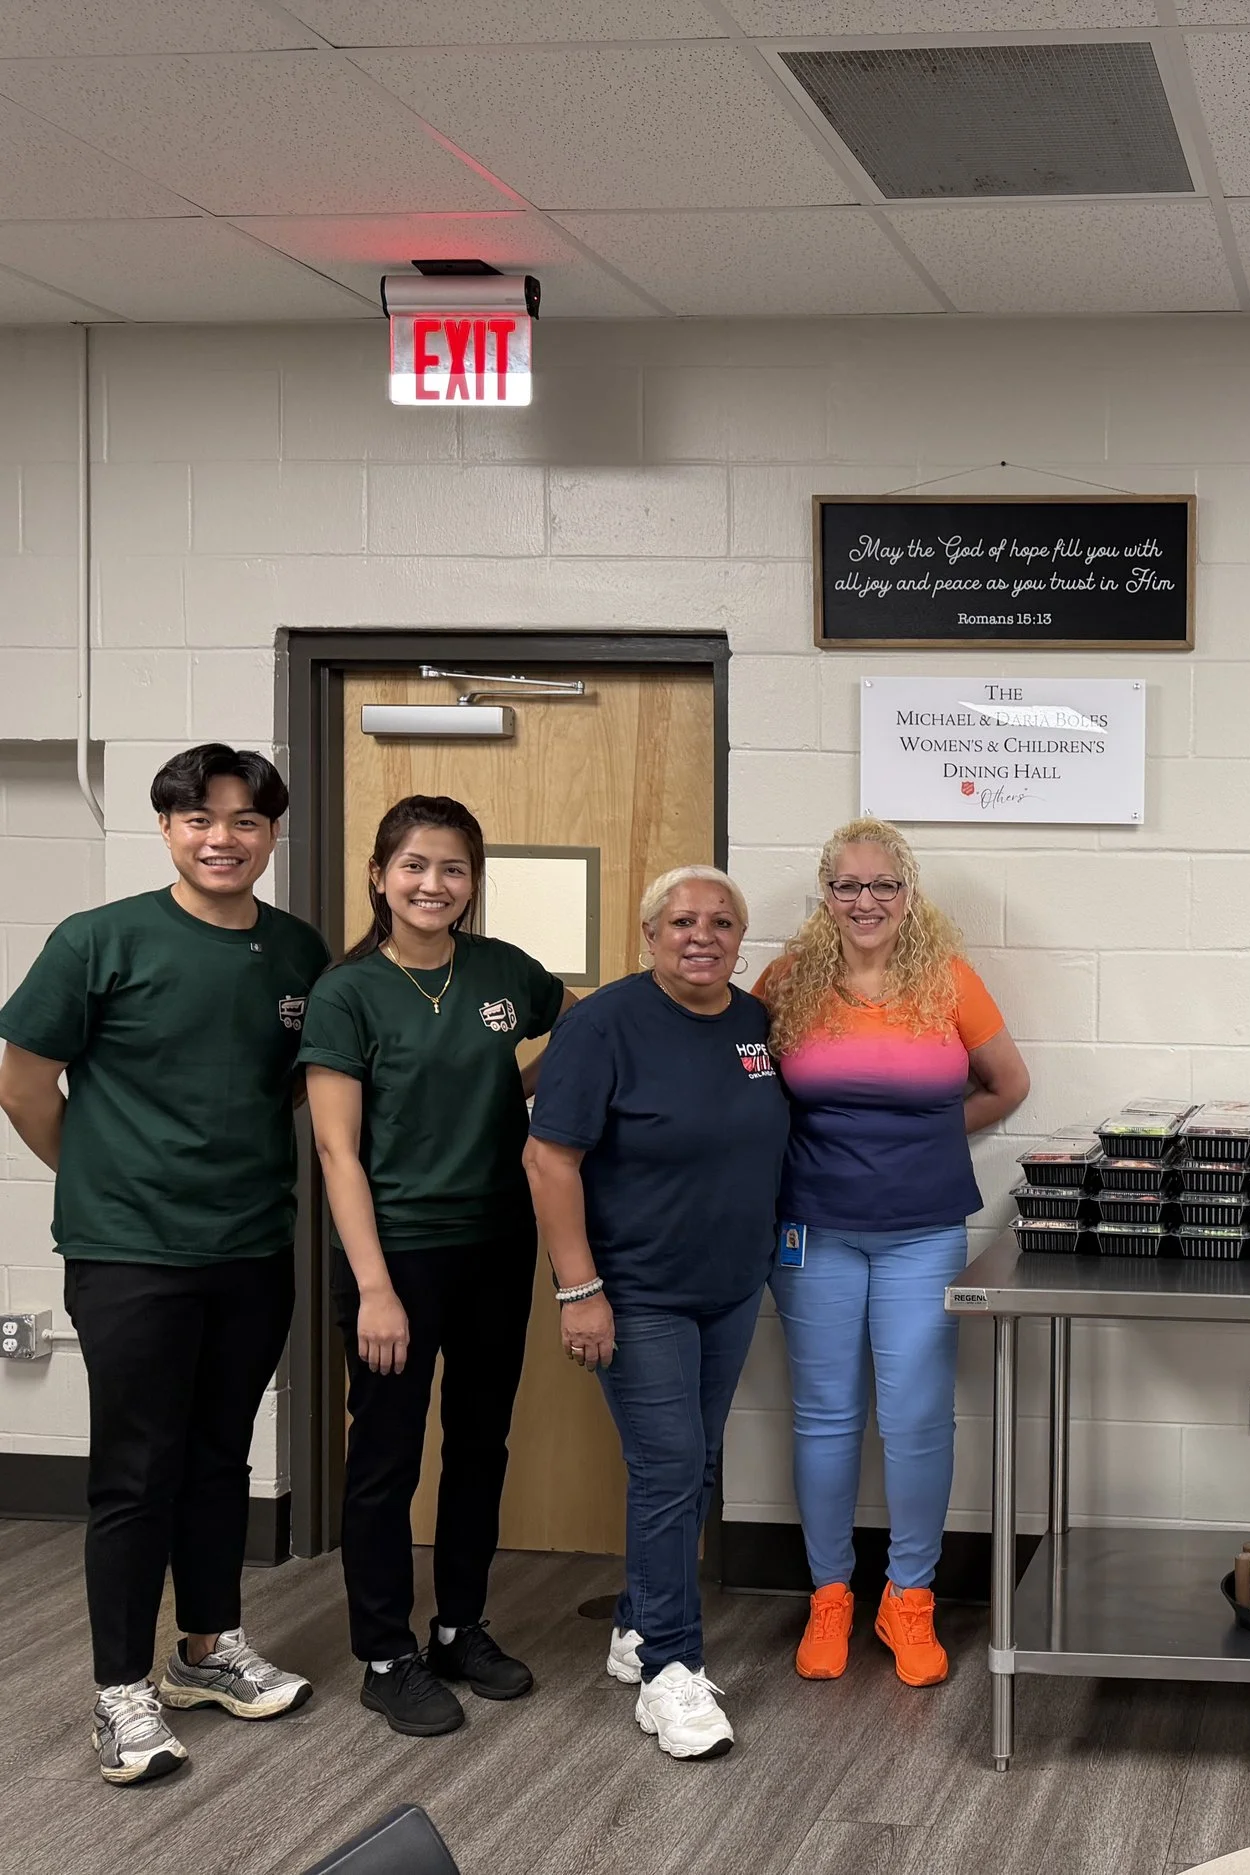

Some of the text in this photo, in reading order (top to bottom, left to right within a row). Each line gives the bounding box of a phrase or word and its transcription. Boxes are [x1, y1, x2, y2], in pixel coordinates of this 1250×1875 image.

[414, 319, 515, 400] EXIT
[848, 534, 1163, 565] May the God of hope fill you with
[834, 567, 1175, 598] all joy and peace as you trust in Him
[957, 612, 1052, 625] Romans 15:13
[979, 713, 991, 726] &
[987, 740, 999, 753] &
[736, 1044, 768, 1056] HOPE
